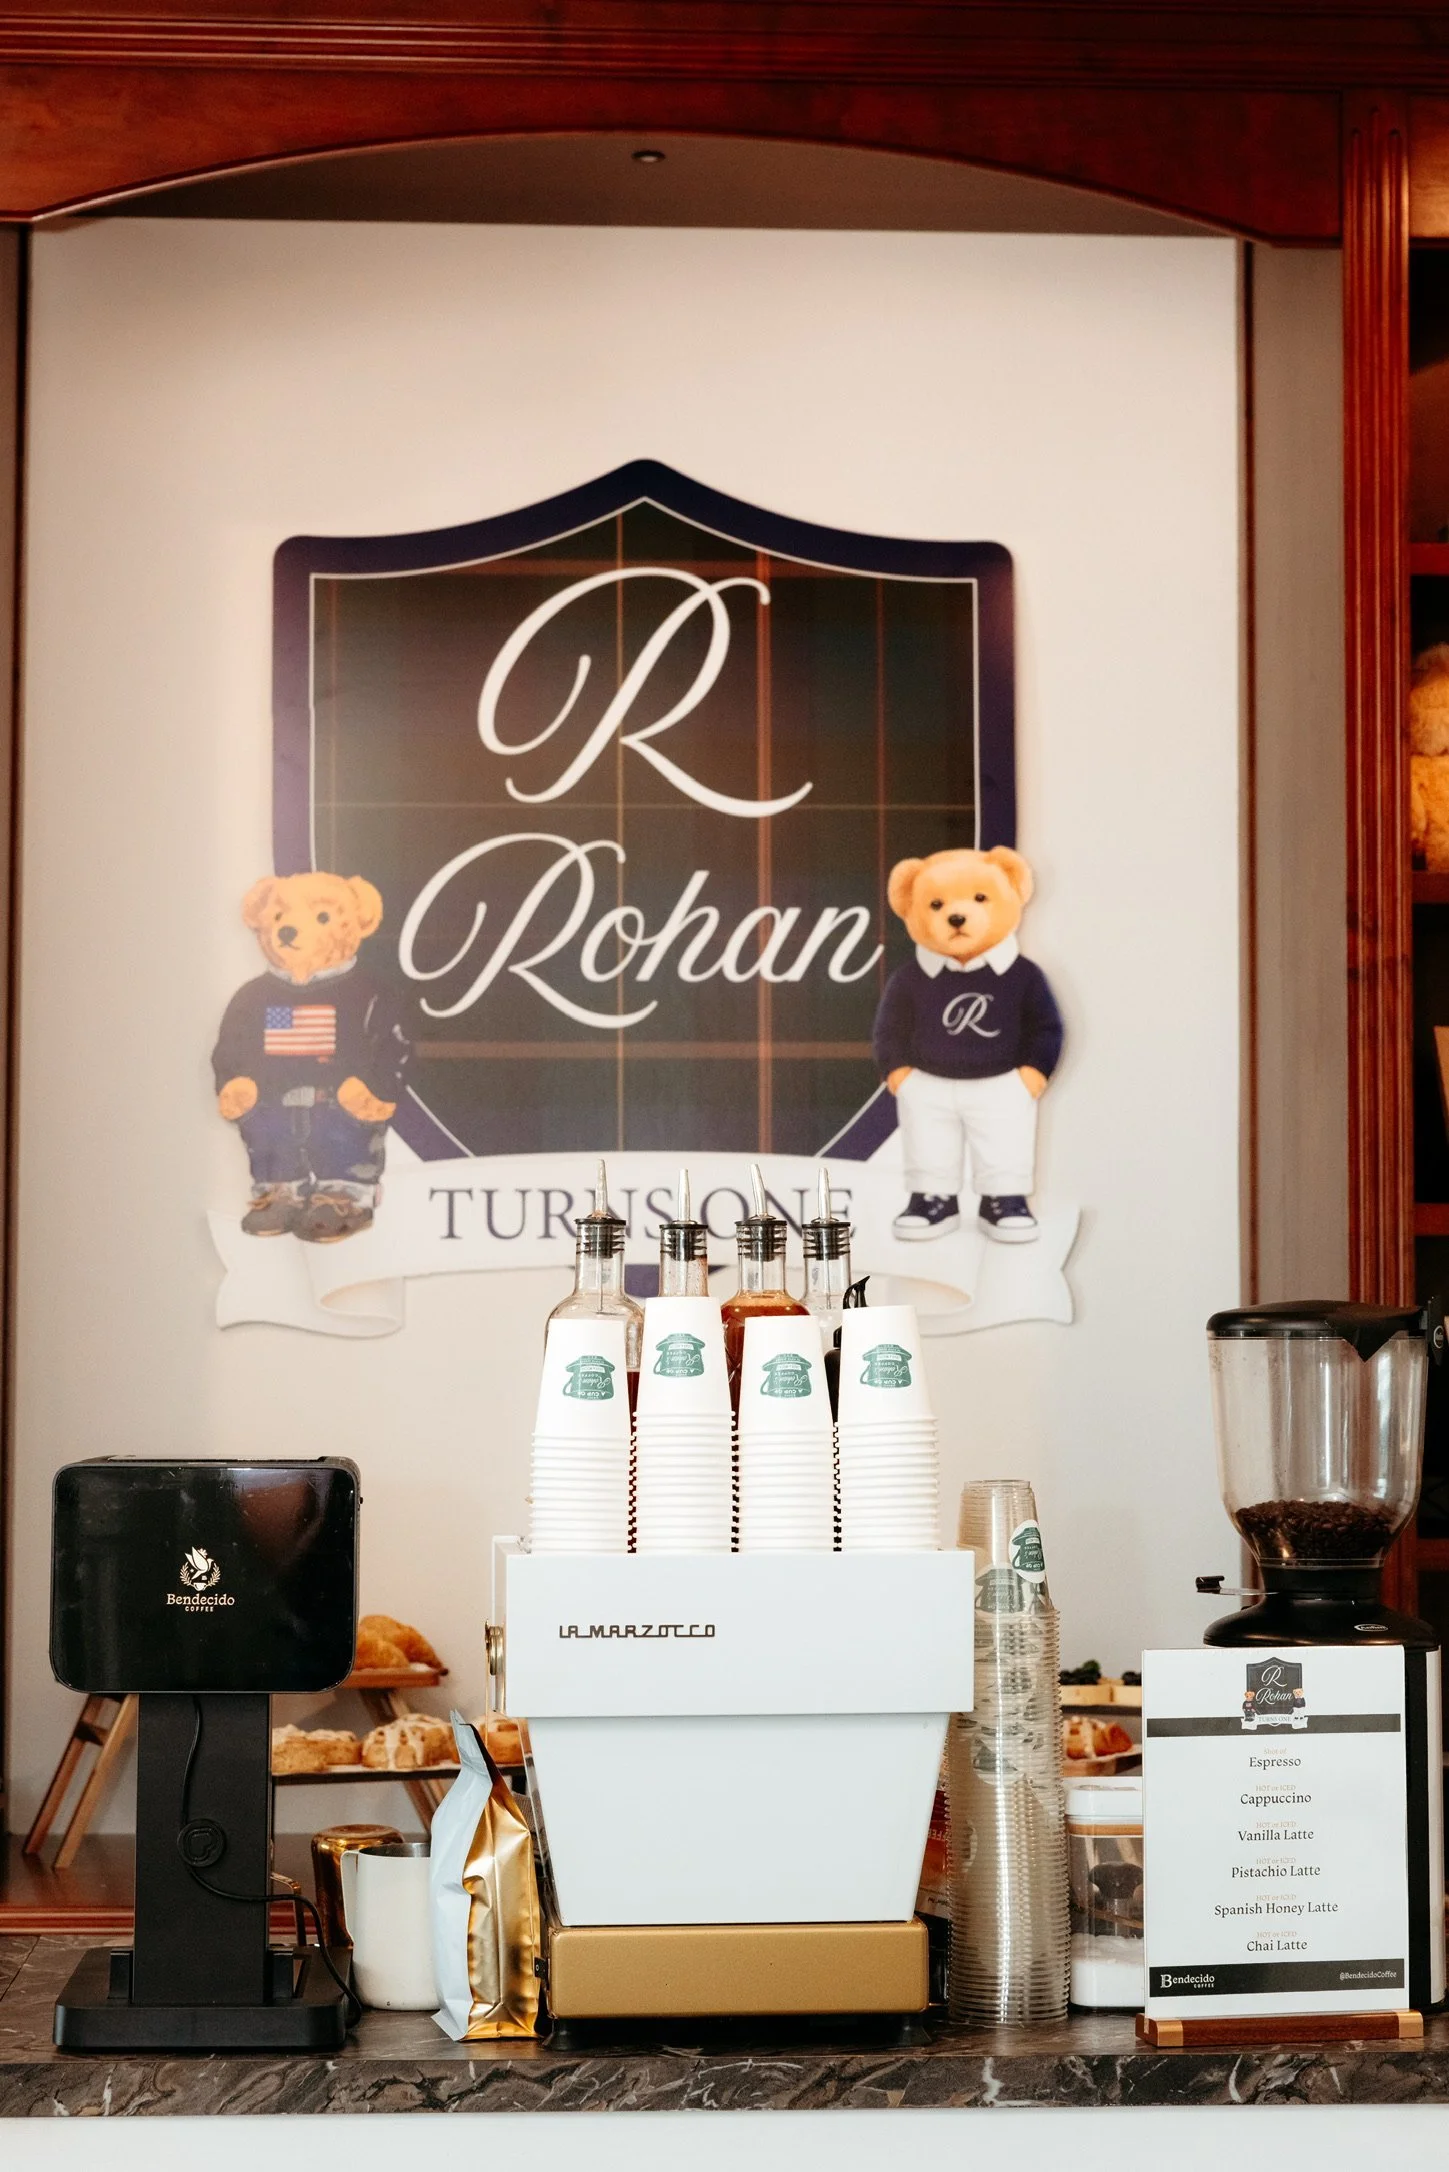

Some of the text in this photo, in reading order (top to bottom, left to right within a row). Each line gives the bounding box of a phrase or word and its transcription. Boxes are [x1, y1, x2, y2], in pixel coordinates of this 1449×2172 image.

[478, 566, 813, 818] R
[398, 832, 884, 1029] Rohan
[942, 992, 1001, 1037] R
[166, 1593, 236, 1606] Bendecido
[1261, 1664, 1288, 1687] R
[1255, 1687, 1293, 1705] Rohan
[1249, 1757, 1302, 1770] Espresso
[1240, 1792, 1312, 1807] Cappuccino
[1238, 1829, 1314, 1841] Vanilla Latte
[1231, 1865, 1321, 1878] Pistachio Latte
[1214, 1902, 1338, 1918] Spanish Honey Latte
[1246, 1940, 1308, 1951] Chai Latte
[1160, 1970, 1397, 1988] Bendecido @BendecidoCoffee
